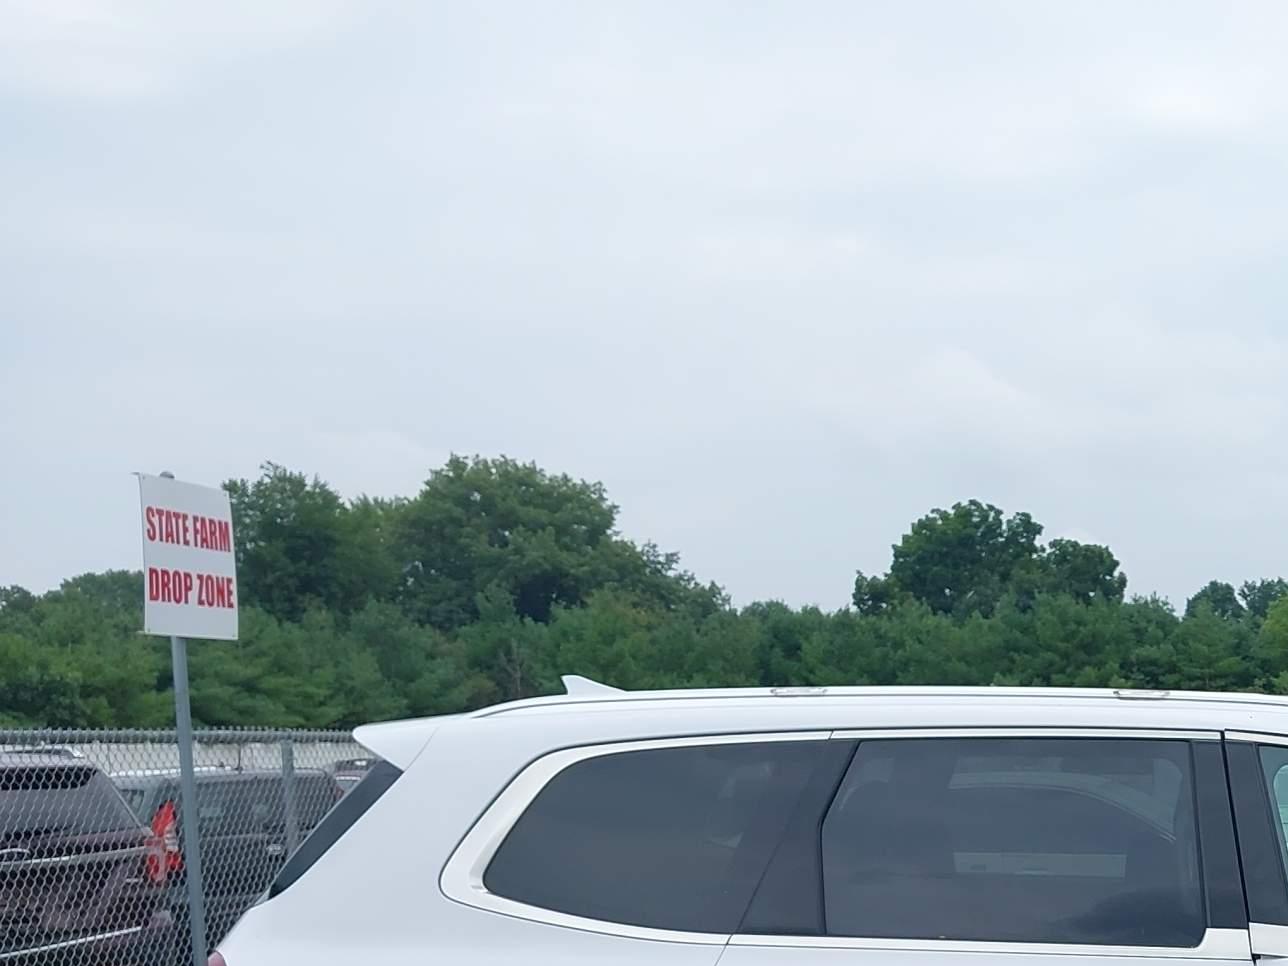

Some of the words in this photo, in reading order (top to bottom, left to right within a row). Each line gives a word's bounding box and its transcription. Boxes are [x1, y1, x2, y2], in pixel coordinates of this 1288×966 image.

[146, 506, 190, 546] STATE
[193, 515, 231, 553] FARM
[149, 567, 193, 605] DROP
[196, 574, 234, 609] ZONE
